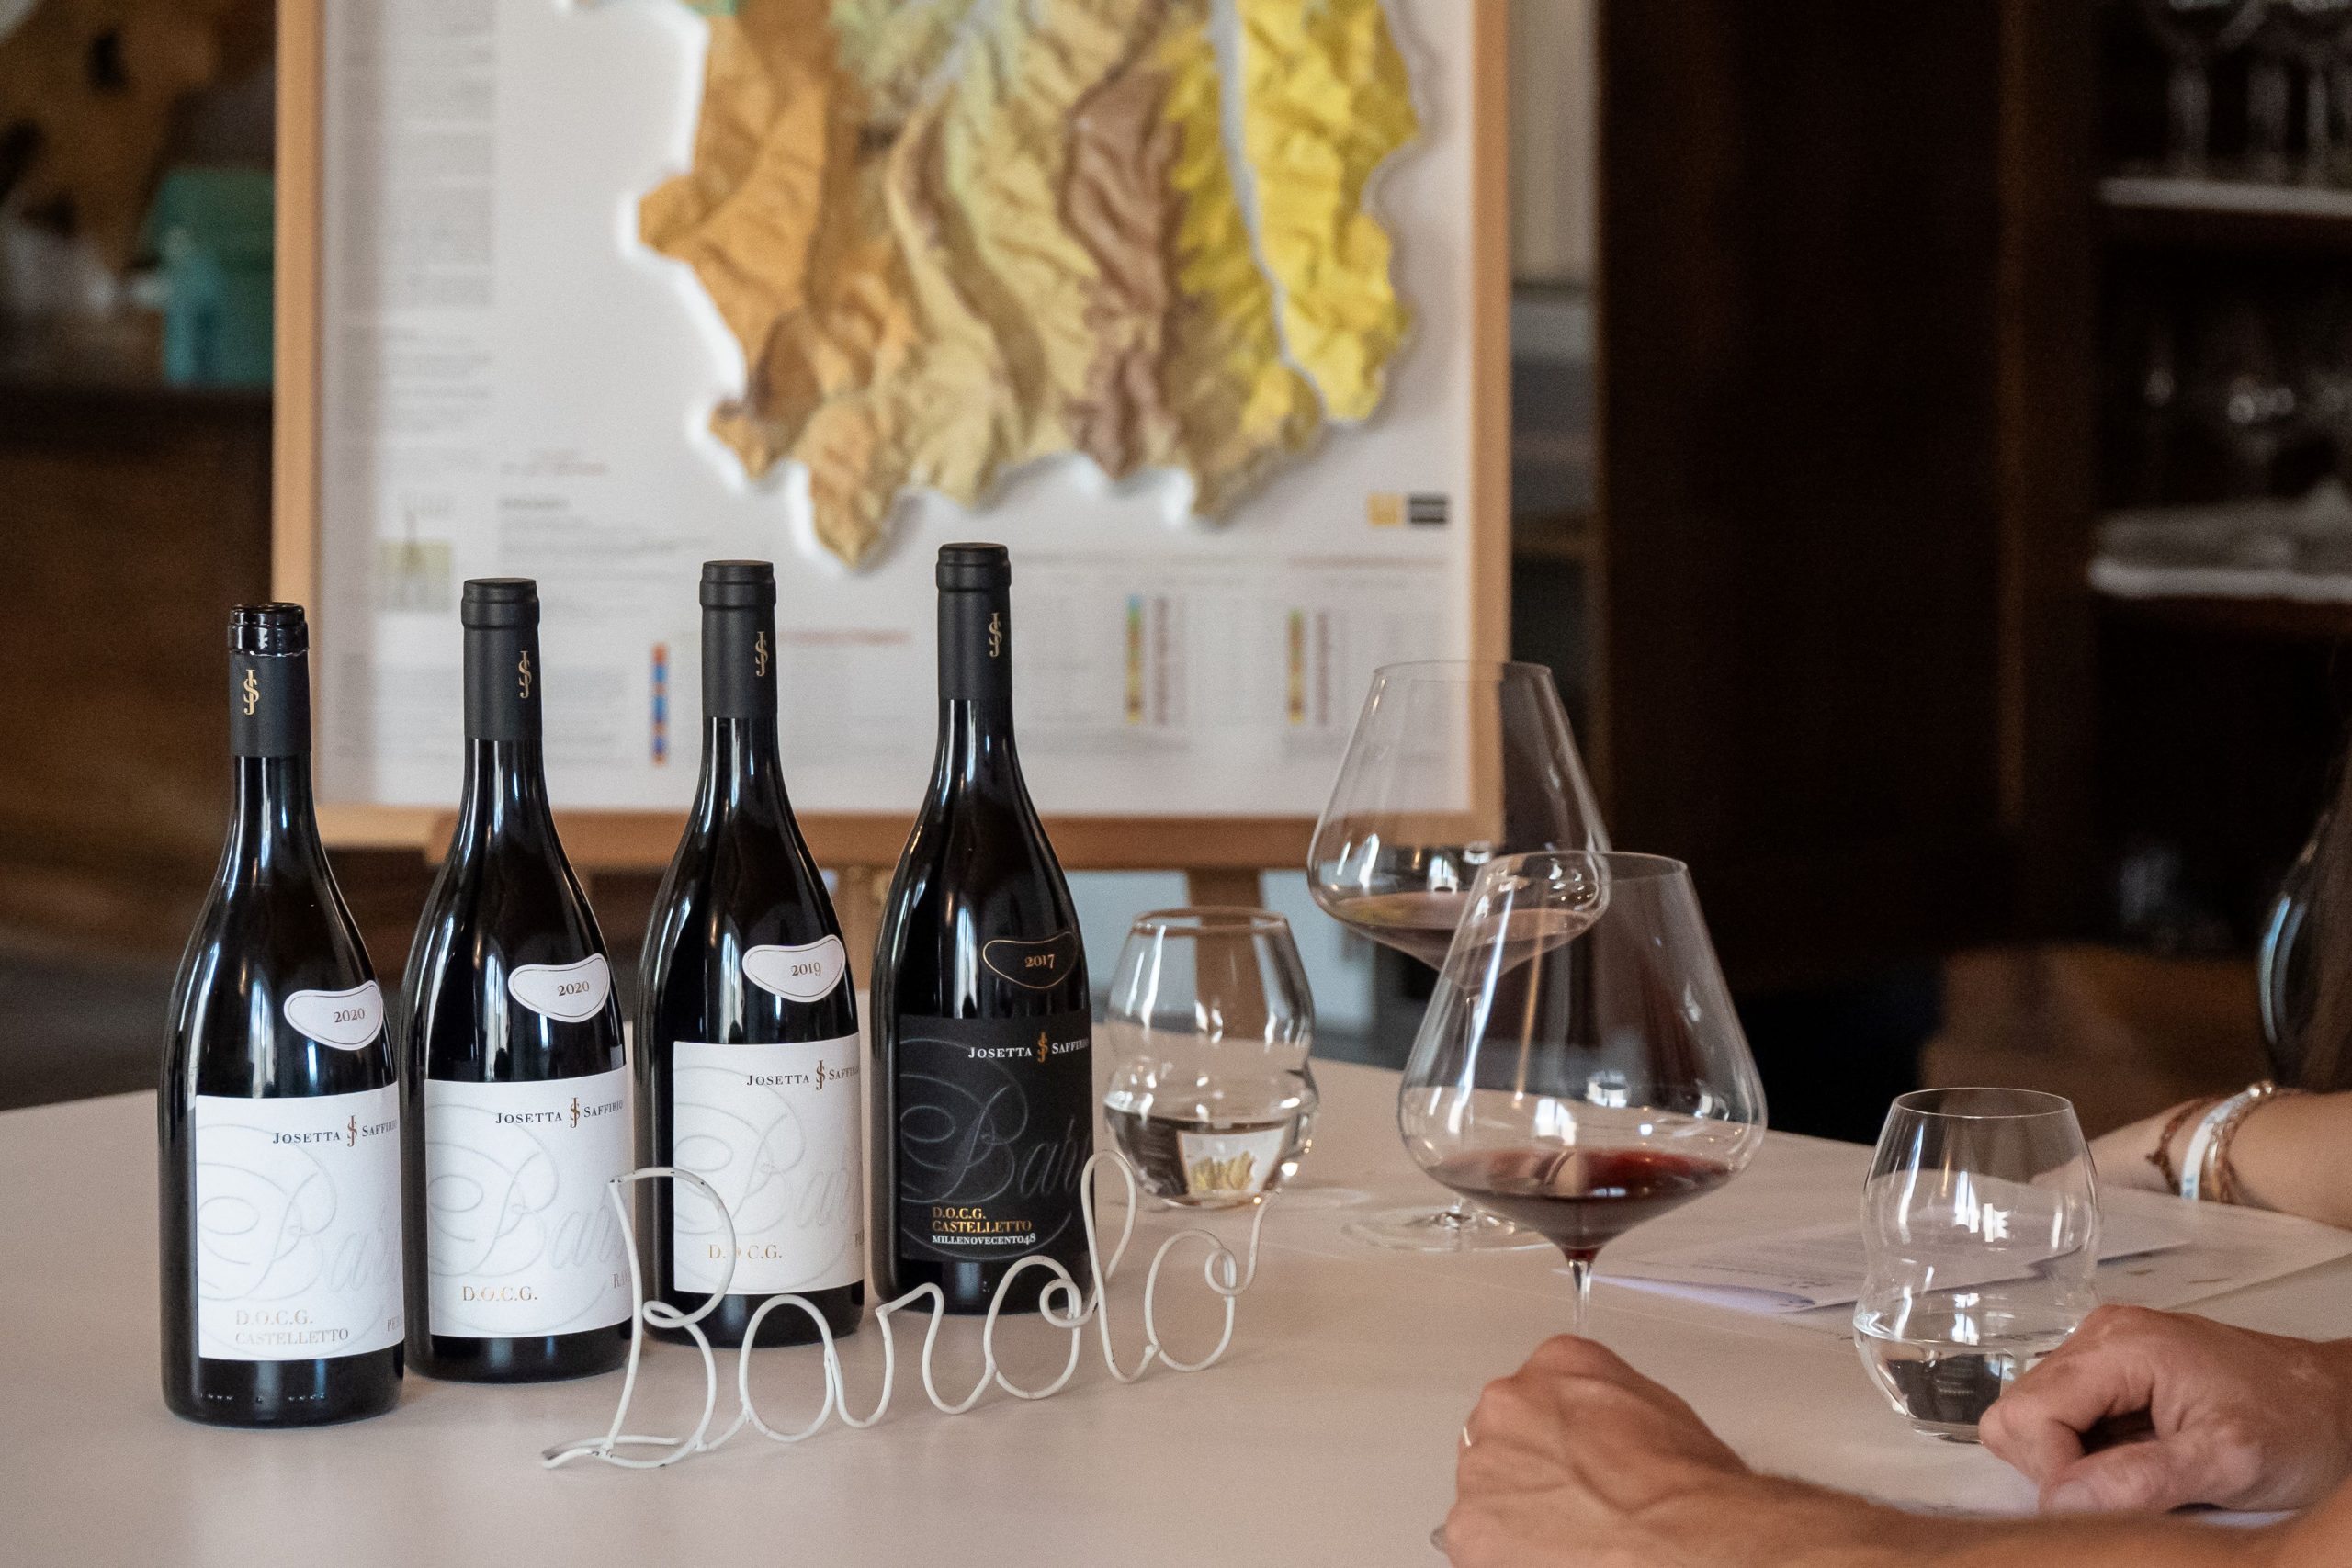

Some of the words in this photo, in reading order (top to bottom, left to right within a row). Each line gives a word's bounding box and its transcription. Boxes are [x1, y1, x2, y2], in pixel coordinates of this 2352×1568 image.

[1024, 953, 1056, 969] 2017
[791, 962, 822, 976] 2019
[557, 980, 590, 996] 2020
[334, 1009, 366, 1023] 2020
[968, 1046, 1033, 1059] JOSETTA
[746, 1074, 810, 1087] JOSETTA
[495, 1111, 562, 1125] JOSETTA
[272, 1131, 341, 1145] JOSETTA
[933, 1207, 987, 1220] D.O.C.G.
[932, 1220, 1033, 1234] CASTELLETTO
[462, 1285, 538, 1302] D.O.C.G.
[235, 1309, 314, 1325] D.O.C.G.
[235, 1327, 349, 1346] CASTELLETTO
